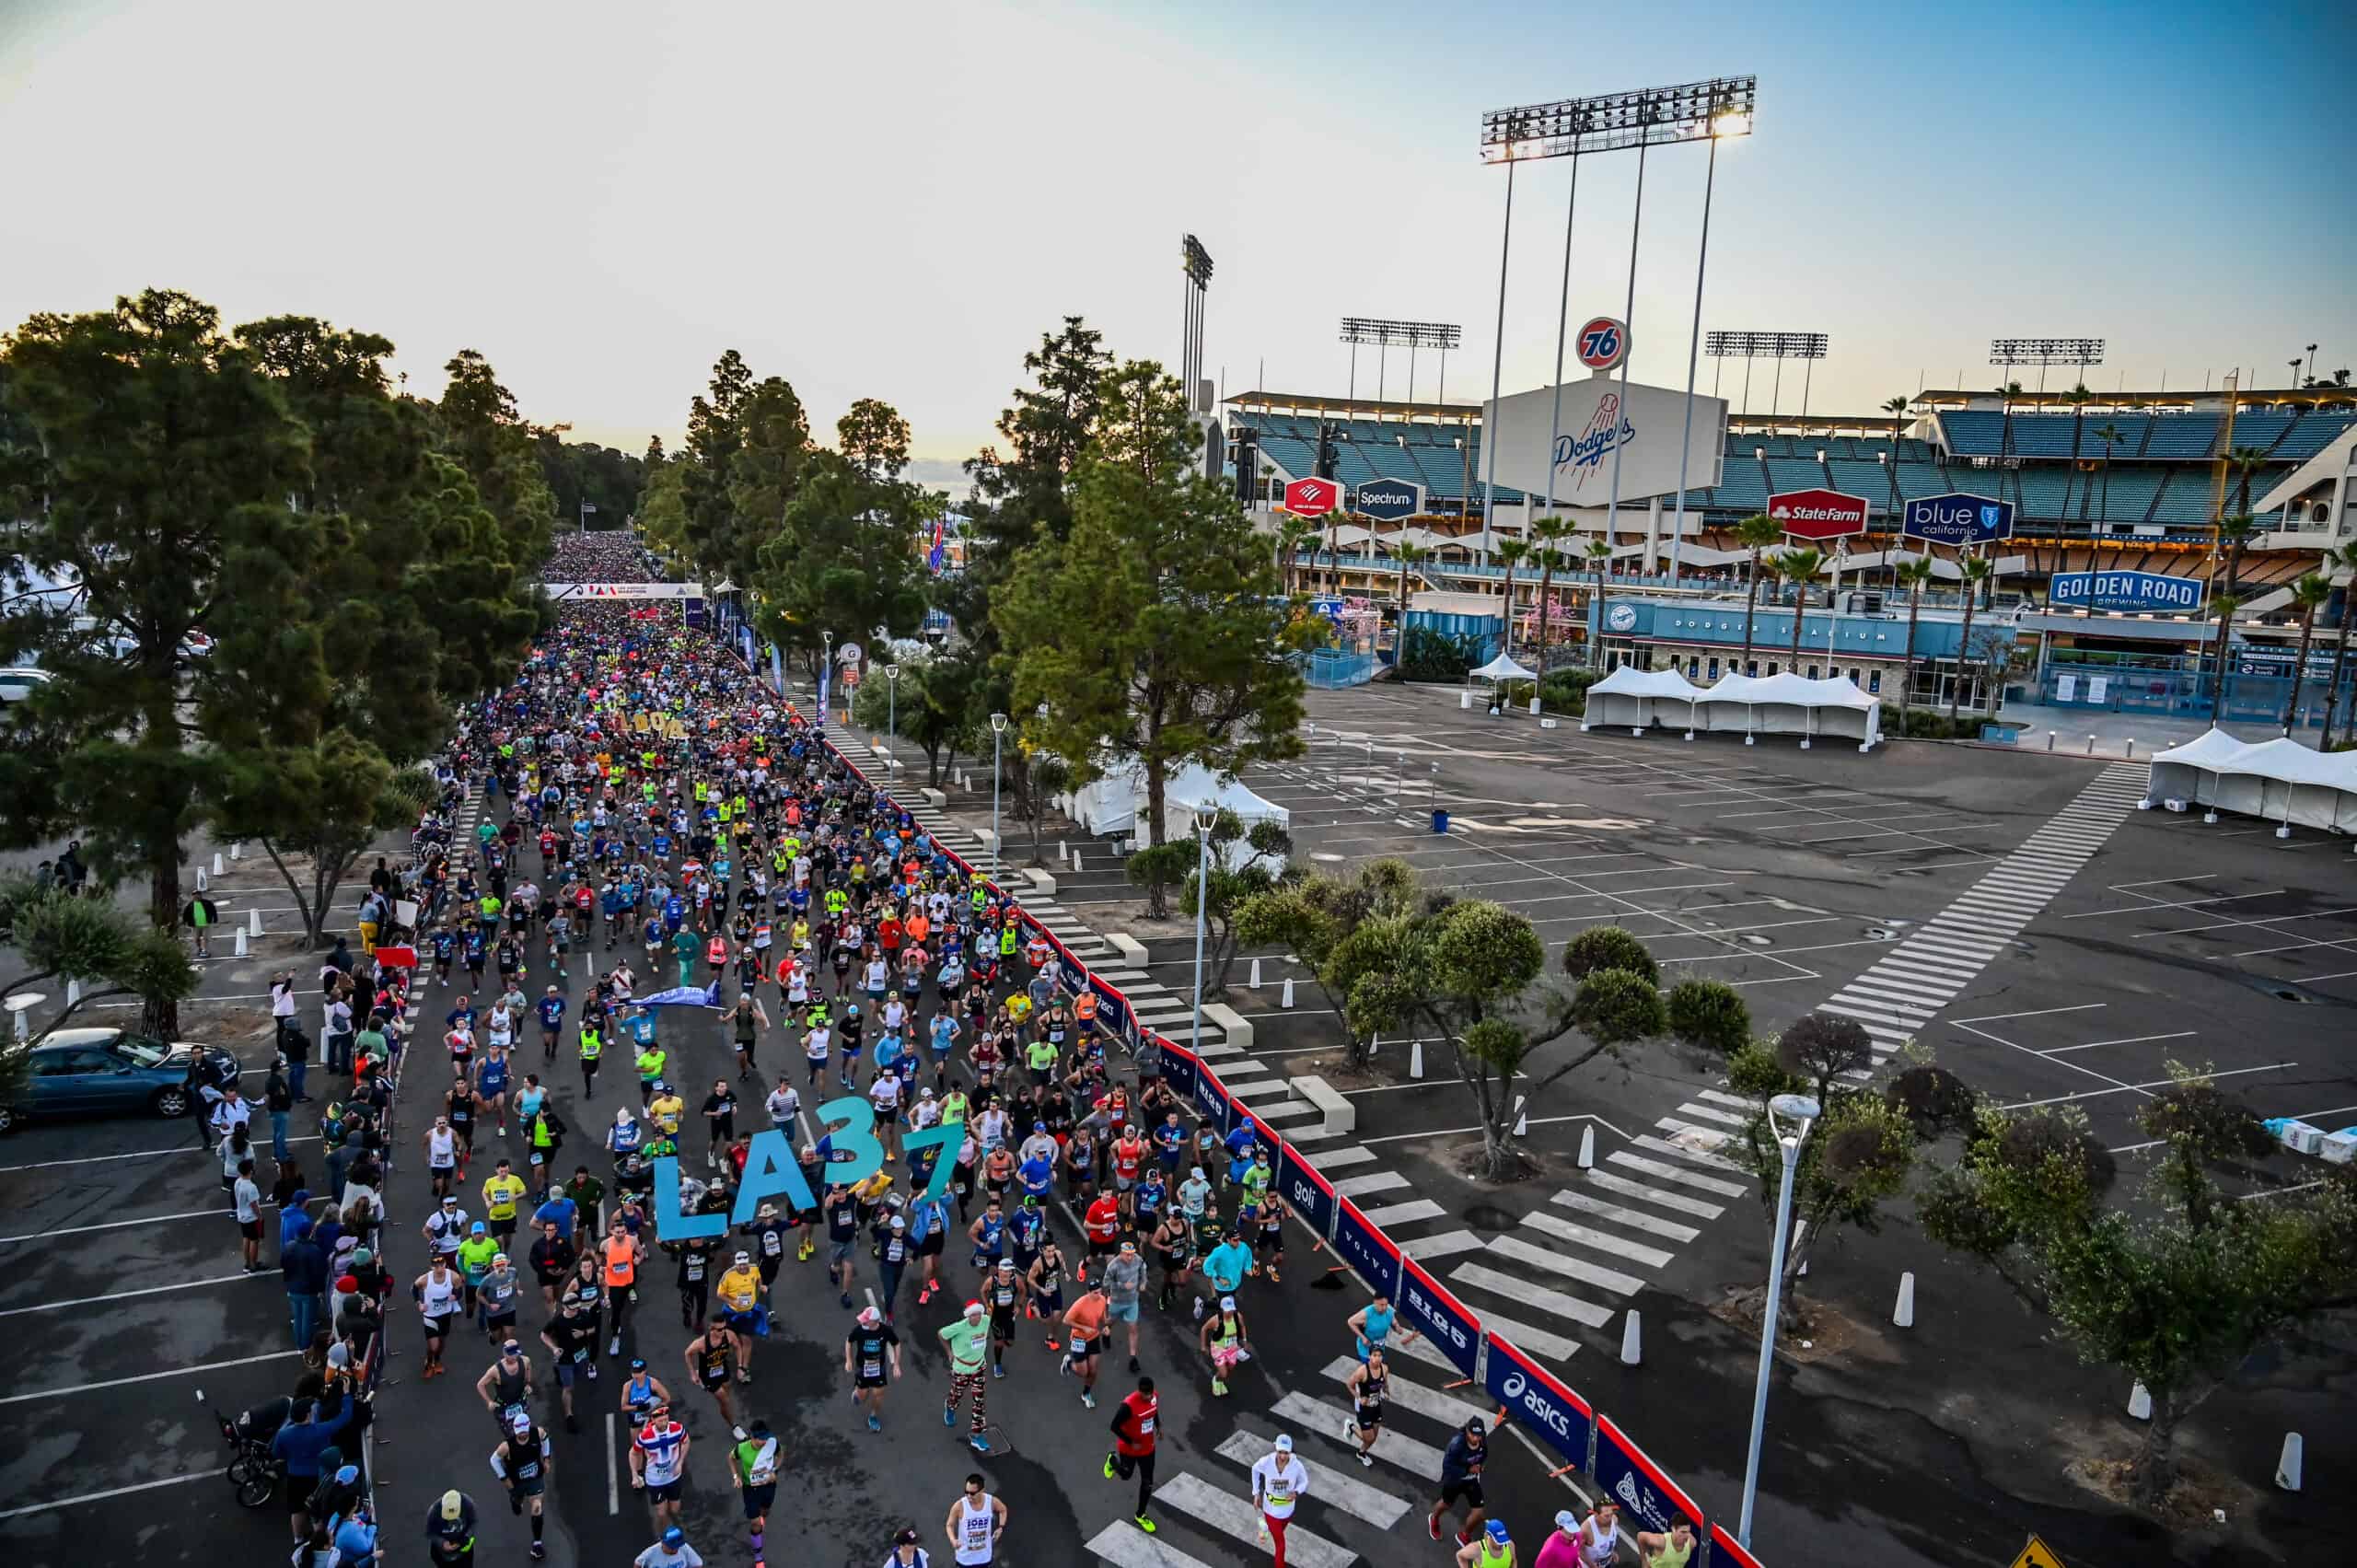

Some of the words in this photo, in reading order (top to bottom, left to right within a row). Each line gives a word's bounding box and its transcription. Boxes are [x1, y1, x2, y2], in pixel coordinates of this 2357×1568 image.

[1584, 328, 1619, 358] 76
[1361, 492, 1410, 506] Spectrum
[1915, 503, 1972, 525] blue
[1922, 525, 1979, 537] california
[2057, 576, 2134, 598] GOLDEN
[2140, 578, 2192, 605] ROAD
[2097, 598, 2148, 608] BREWING
[1782, 626, 1886, 641] SAIUM
[847, 650, 856, 658] G
[1295, 1179, 1317, 1210] goli
[1345, 1230, 1388, 1279] VOLVO
[1524, 1388, 1569, 1436] asics
